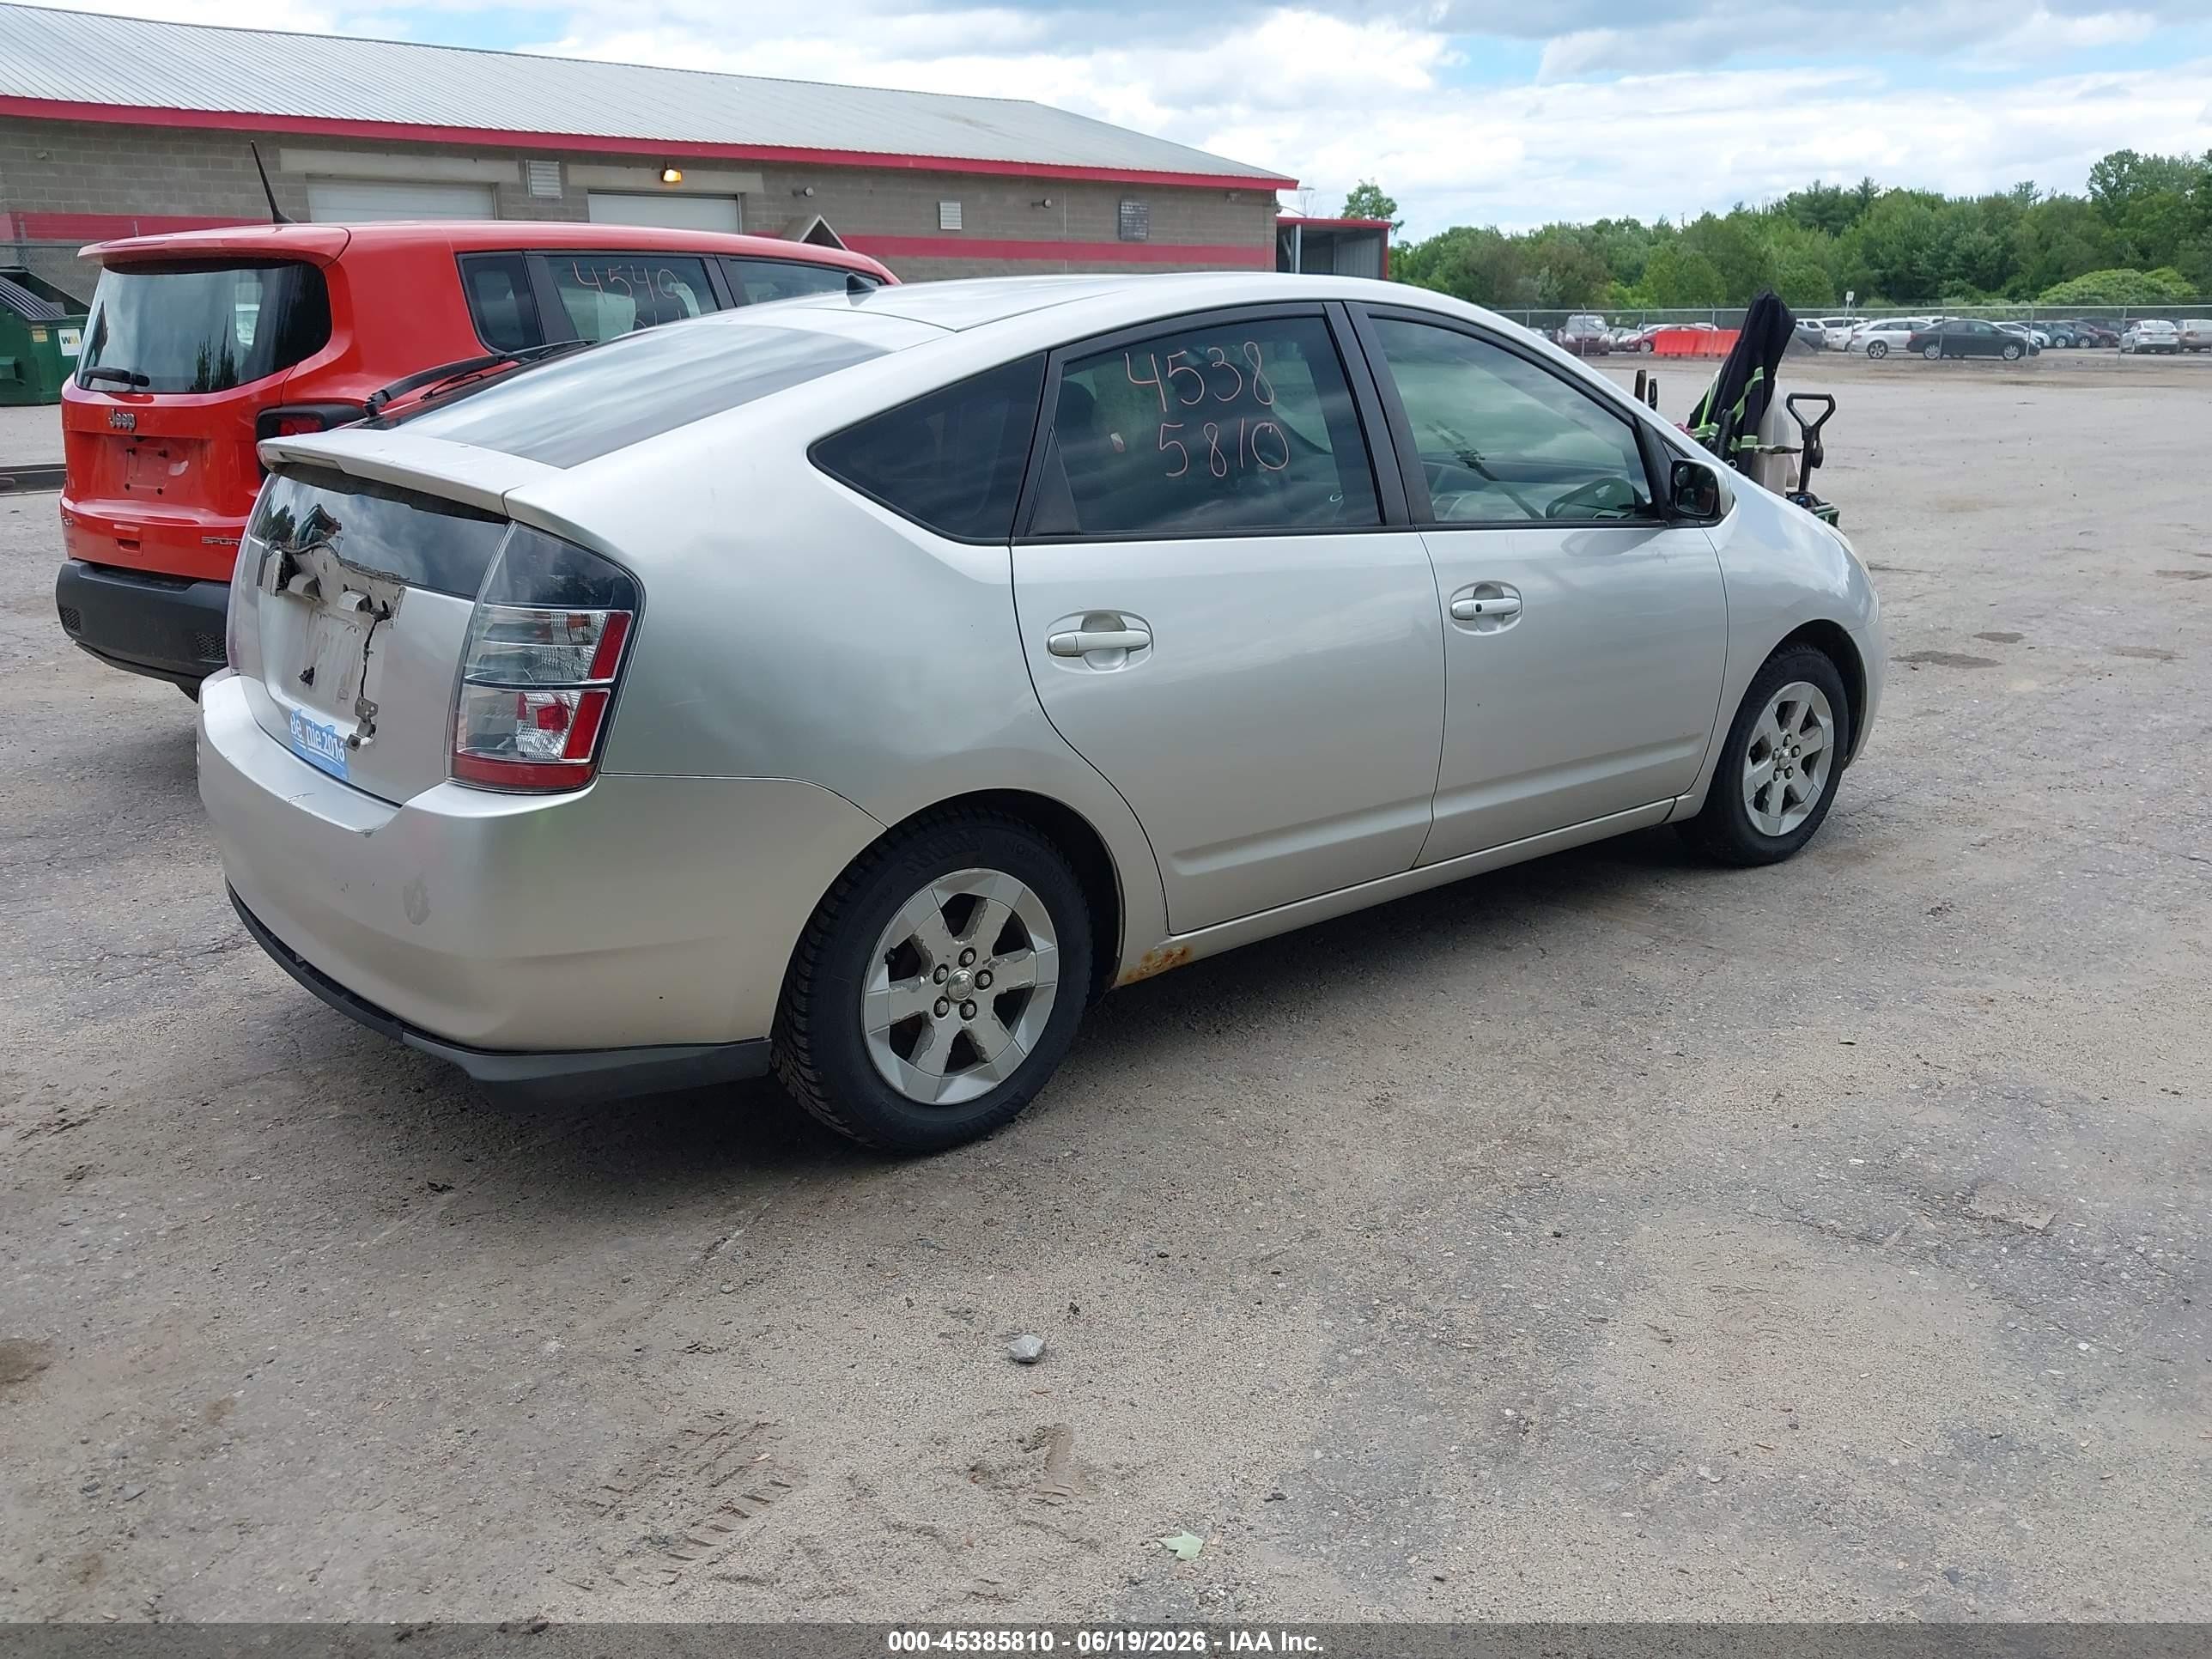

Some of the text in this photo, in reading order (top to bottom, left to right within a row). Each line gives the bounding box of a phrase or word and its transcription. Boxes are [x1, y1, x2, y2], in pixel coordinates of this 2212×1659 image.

[573, 260, 680, 304] 4540
[61, 336, 81, 344] WM
[1125, 341, 1274, 412] 4538
[108, 408, 137, 432] Jeep
[1159, 417, 1289, 477] 5810
[201, 536, 242, 546] SPOR
[289, 712, 322, 750] Benie
